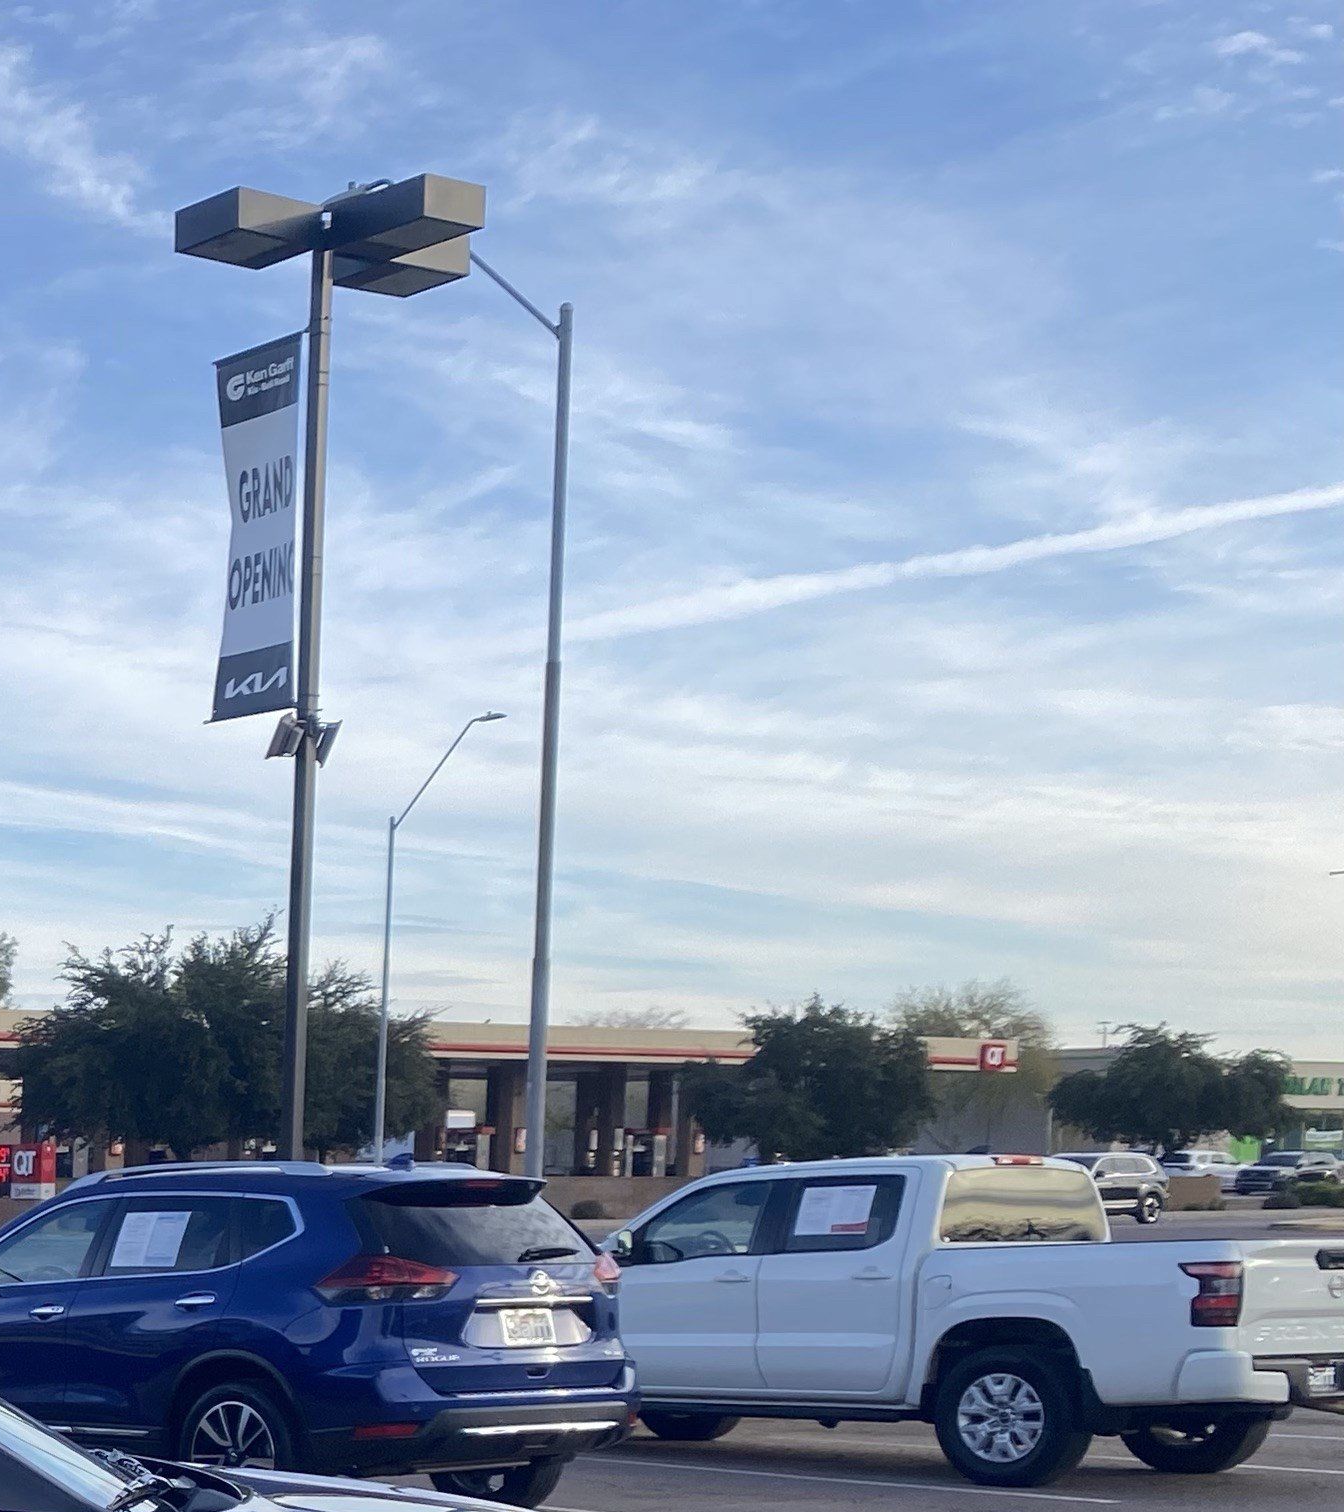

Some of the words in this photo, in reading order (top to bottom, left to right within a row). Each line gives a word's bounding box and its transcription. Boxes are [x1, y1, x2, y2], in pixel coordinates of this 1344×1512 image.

[239, 455, 293, 523] GRAND
[224, 666, 288, 699] KIA
[14, 1150, 36, 1176] QT
